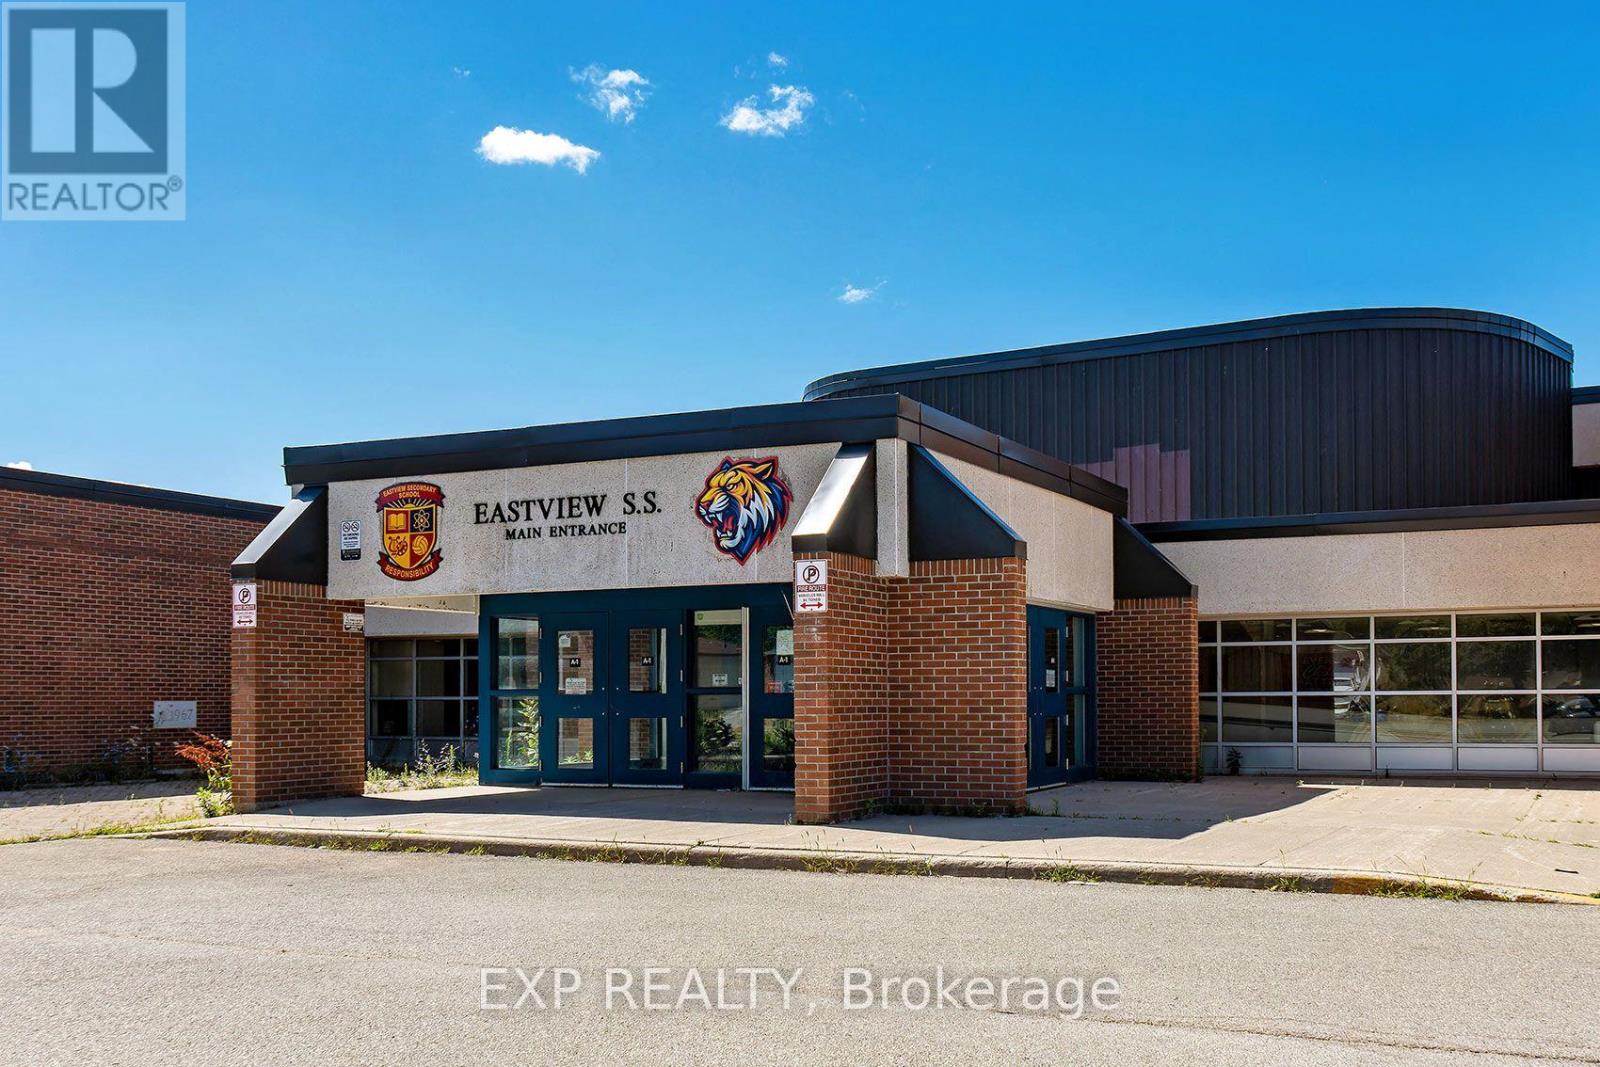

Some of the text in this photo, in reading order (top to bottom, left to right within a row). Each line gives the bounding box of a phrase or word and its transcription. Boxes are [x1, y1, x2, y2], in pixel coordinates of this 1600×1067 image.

[473, 491, 662, 525] EASTVIEW S.S.
[505, 522, 628, 541] MAIN ENTRANCE
[385, 561, 435, 579] RESPONSIBILITY
